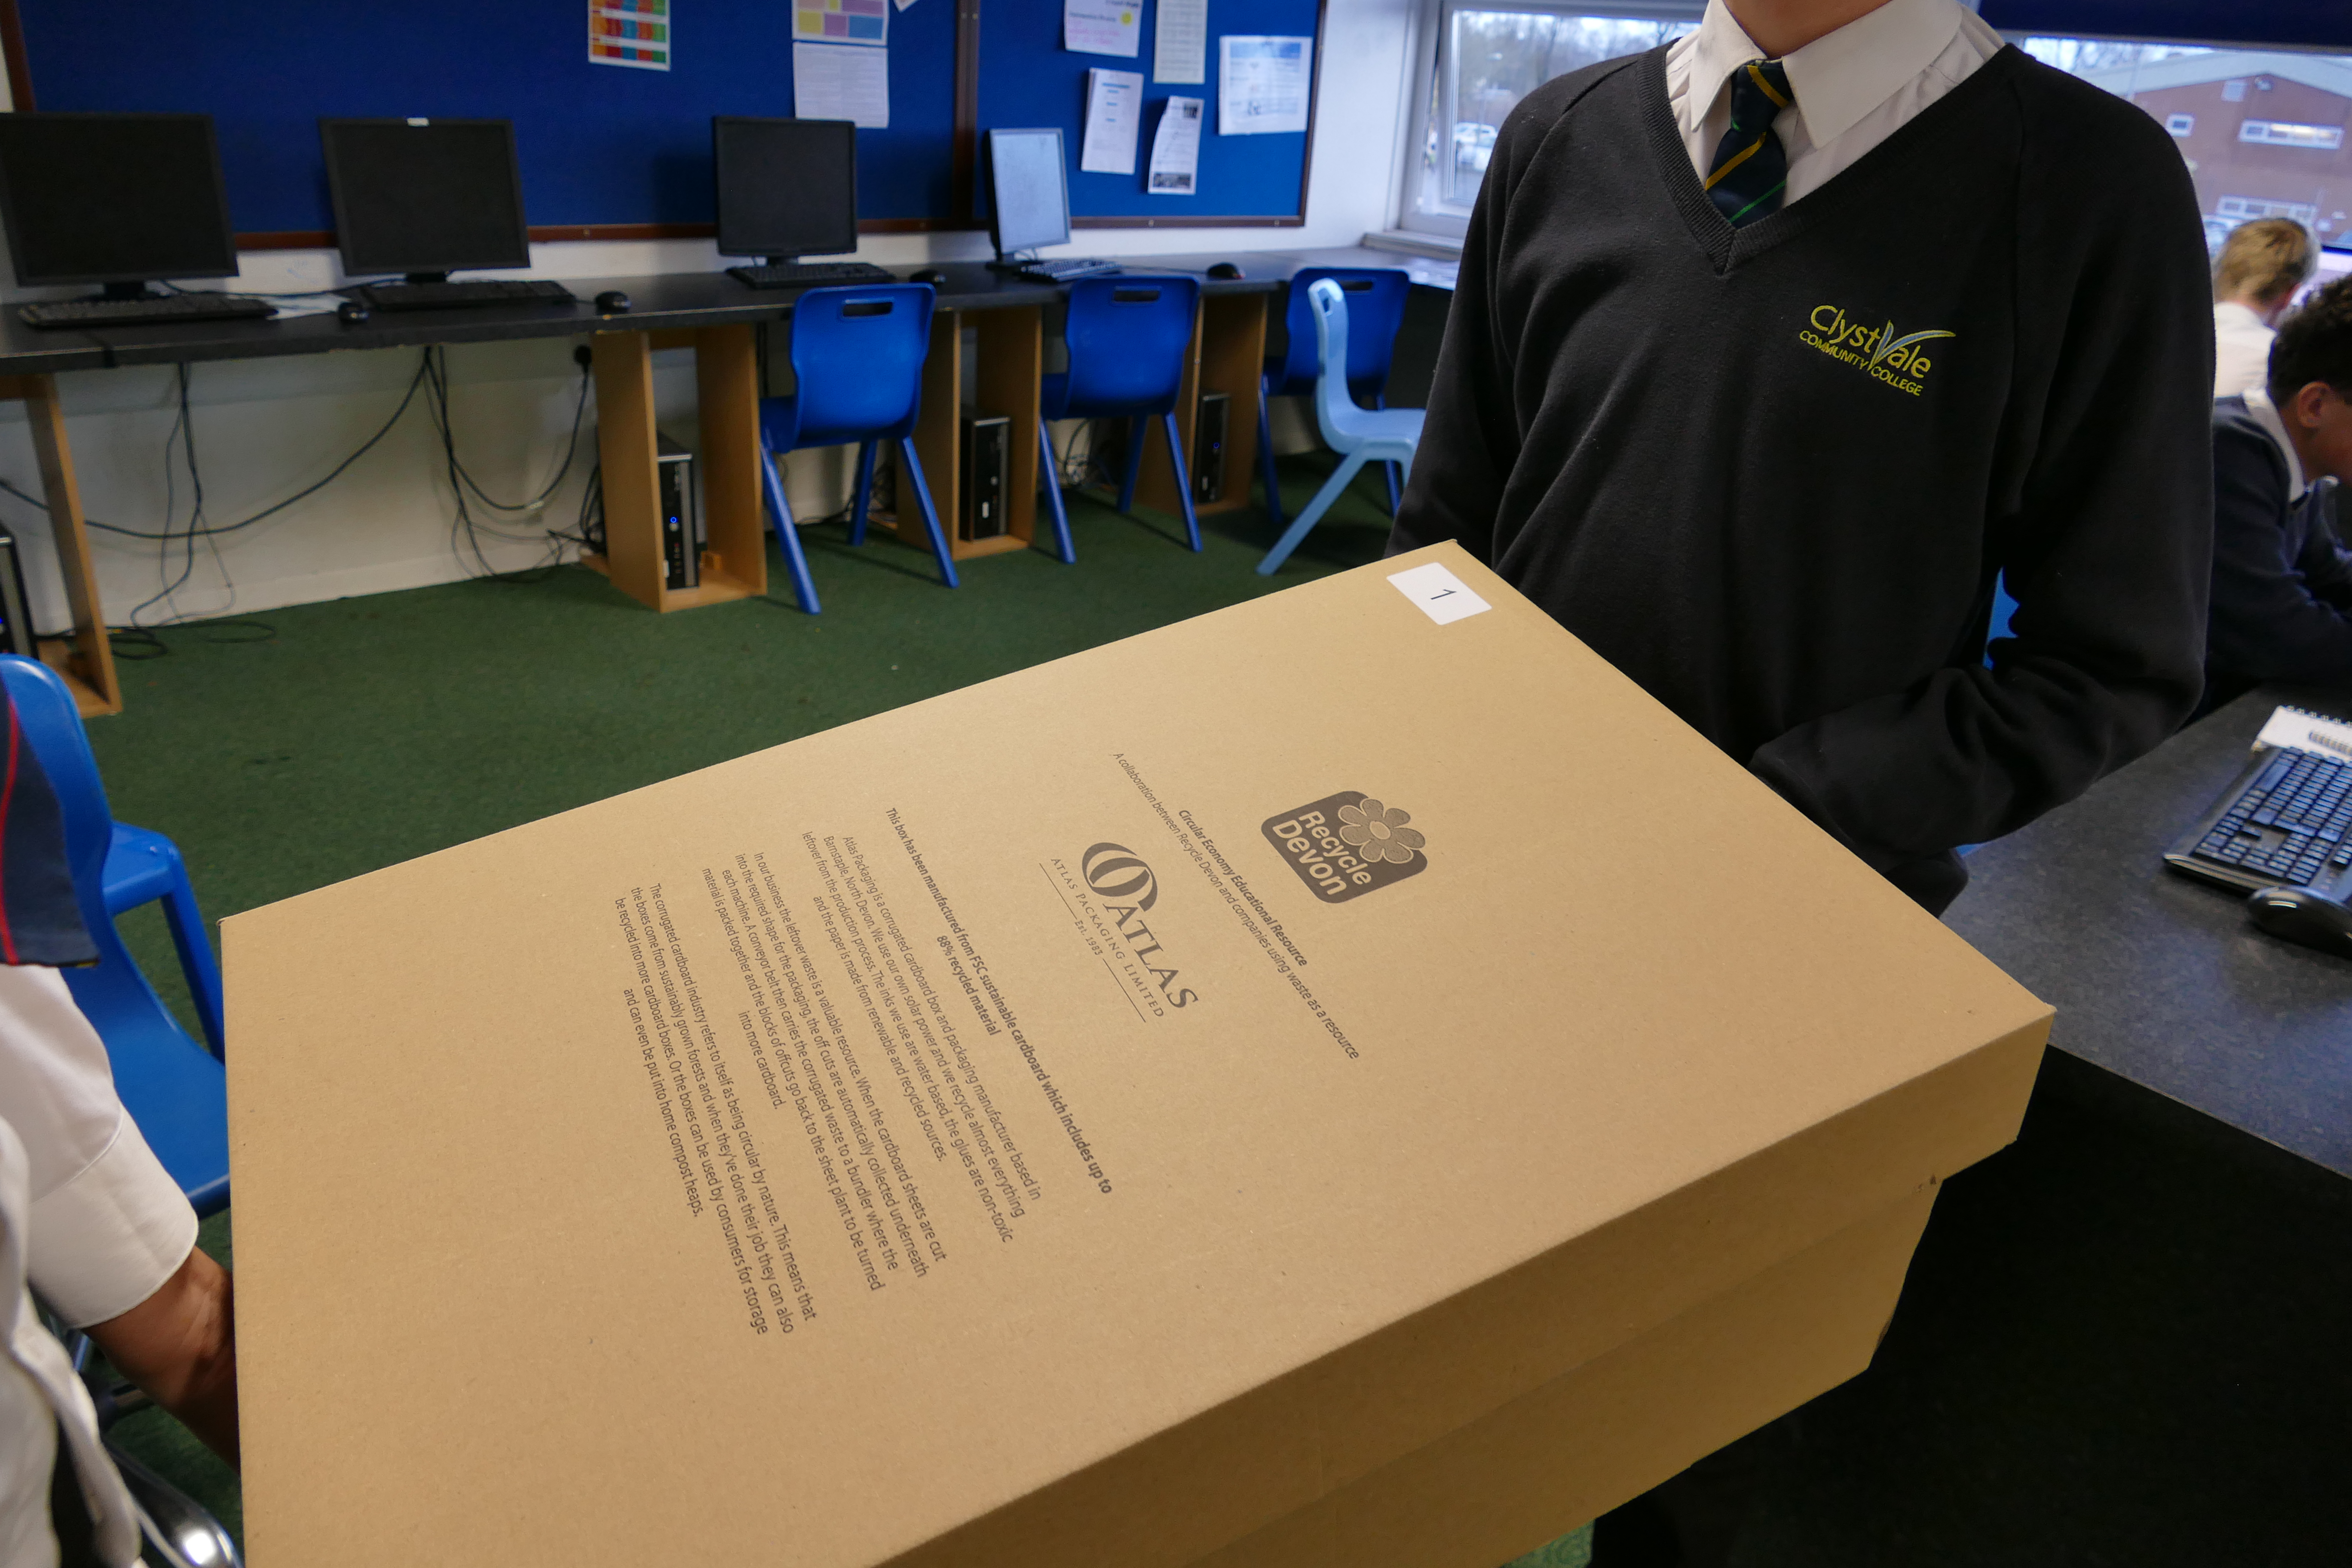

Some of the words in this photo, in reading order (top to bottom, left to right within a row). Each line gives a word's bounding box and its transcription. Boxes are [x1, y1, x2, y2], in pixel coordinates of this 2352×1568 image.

[1800, 330, 1869, 370] COMMUNITY
[1871, 366, 1923, 396] COLLEGE
[1430, 589, 1457, 600] 1
[754, 852, 764, 861] In
[802, 831, 822, 860] leftover
[842, 837, 858, 854] Atlas
[1272, 820, 1347, 894] Devon
[1298, 811, 1371, 885] Recycle
[758, 862, 770, 874] our
[816, 860, 830, 879] from
[852, 854, 878, 894] Packaging
[631, 887, 643, 901] the
[650, 883, 662, 899] The
[764, 874, 785, 909] business
[825, 879, 837, 893] the
[873, 893, 883, 901] is
[1179, 810, 1206, 839] Circular
[1201, 839, 1235, 875] Economy
[1230, 875, 1278, 925] Educational
[1270, 924, 1307, 966] Resource
[615, 897, 626, 910] be
[636, 900, 651, 925] boxes
[779, 909, 791, 923] the
[829, 894, 859, 937] production
[1118, 760, 1156, 802] collaboration
[1152, 802, 1180, 834] between
[1176, 833, 1203, 862] Recycle
[1199, 861, 1223, 888] Devon
[1219, 888, 1239, 904] and
[1232, 904, 1271, 948] companies
[1267, 948, 1291, 973] using
[1287, 972, 1311, 999] waste
[1307, 999, 1321, 1011] as
[1322, 1018, 1359, 1059] resource
[619, 910, 640, 943] recycled
[655, 900, 680, 943] corrugated
[880, 908, 913, 952] corrugated
[644, 926, 658, 949] come
[785, 922, 806, 954] leftover
[1051, 859, 1078, 889] ATLAS
[1075, 893, 1125, 959] PACKAGING
[1124, 964, 1164, 1017] LIMITED
[1075, 920, 1087, 935] Est.
[1085, 937, 1103, 955] 1983
[630, 943, 642, 960] into
[652, 948, 666, 970] from
[671, 944, 697, 986] cardboard
[851, 938, 876, 972] process.
[1102, 903, 1198, 1008] ATLAS
[636, 961, 650, 984] more
[800, 955, 817, 981] waste
[871, 970, 885, 989] The
[904, 953, 936, 996] cardboard
[659, 970, 685, 1018] sustainably
[811, 980, 822, 989] is
[879, 988, 895, 1007] inks
[937, 935, 956, 956] 88%
[948, 956, 979, 995] recycled
[969, 995, 1001, 1035] material
[644, 985, 669, 1030] cardboard
[686, 986, 707, 1023] industry
[886, 808, 900, 824] This
[894, 824, 909, 840] box
[903, 839, 917, 854] has
[911, 854, 928, 875] been
[923, 875, 965, 934] manufactured
[956, 934, 974, 956] from
[969, 956, 988, 974] FSC
[980, 975, 1017, 1029] sustainable
[1011, 1029, 1050, 1081] cardboard
[1041, 1081, 1068, 1115] which
[1060, 1113, 1094, 1162] includes
[1088, 1162, 1103, 1179] up
[1098, 1179, 1112, 1194] to
[927, 995, 942, 1015] box
[818, 996, 843, 1035] valuable
[889, 1008, 901, 1022] we
[937, 1015, 956, 1033] and
[659, 1029, 675, 1060] boxes.
[673, 1020, 694, 1049] grown
[700, 1024, 716, 1050] refers
[897, 1023, 910, 1040] use
[710, 1050, 720, 1062] to
[836, 1035, 860, 1078] resource.
[905, 1041, 919, 1056] are
[943, 1034, 979, 1084] packaging
[669, 1061, 682, 1073] Or
[687, 1049, 705, 1082] forests
[714, 1061, 734, 1086] itself
[722, 870, 738, 888] each
[730, 888, 750, 924] machine.
[748, 932, 771, 969] conveyor
[764, 969, 780, 989] belt
[772, 988, 787, 1010] then
[781, 1011, 800, 1040] carries
[794, 1041, 807, 1057] the
[802, 1059, 835, 1112] corrugated
[825, 1112, 844, 1143] waste
[838, 1144, 849, 1156] to
[847, 1165, 873, 1209] bundler
[866, 1211, 888, 1248] where
[882, 1248, 898, 1270] the
[913, 1056, 934, 1084] water
[673, 1074, 687, 1092] the
[698, 1083, 716, 1102] and
[723, 1087, 734, 1099] as
[856, 1077, 875, 1108] When
[679, 1091, 697, 1122] boxes
[727, 1098, 745, 1130] being
[927, 1084, 952, 1119] based,
[706, 1103, 723, 1133] when
[869, 1108, 884, 1127] the
[944, 1118, 959, 1137] the
[973, 1084, 1016, 1152] manufacturer
[689, 1124, 703, 1143] can
[696, 1142, 709, 1158] be
[739, 1131, 760, 1168] circular
[878, 1128, 913, 1182] cardboard
[950, 1139, 975, 1167] glues
[702, 1159, 722, 1186] used
[751, 1169, 766, 1184] by
[969, 1169, 984, 1187] are
[1010, 1152, 1038, 1187] based
[709, 1185, 724, 1201] by
[730, 1174, 747, 1203] done
[902, 1183, 926, 1219] sheets
[1028, 1187, 1041, 1200] in
[741, 1203, 760, 1230] their
[758, 1186, 779, 1226] nature.
[978, 1187, 1013, 1243] non-toxic
[717, 1204, 745, 1266] consumers
[746, 1231, 768, 1252] job
[773, 1224, 791, 1251] This
[919, 1221, 935, 1240] are
[929, 1241, 947, 1262] cut
[737, 1266, 752, 1284] for
[758, 1253, 775, 1280] they
[782, 1252, 805, 1292] means
[769, 1283, 784, 1306] can
[797, 1293, 817, 1321] that
[744, 1287, 768, 1335] storage
[776, 1308, 793, 1333] also
